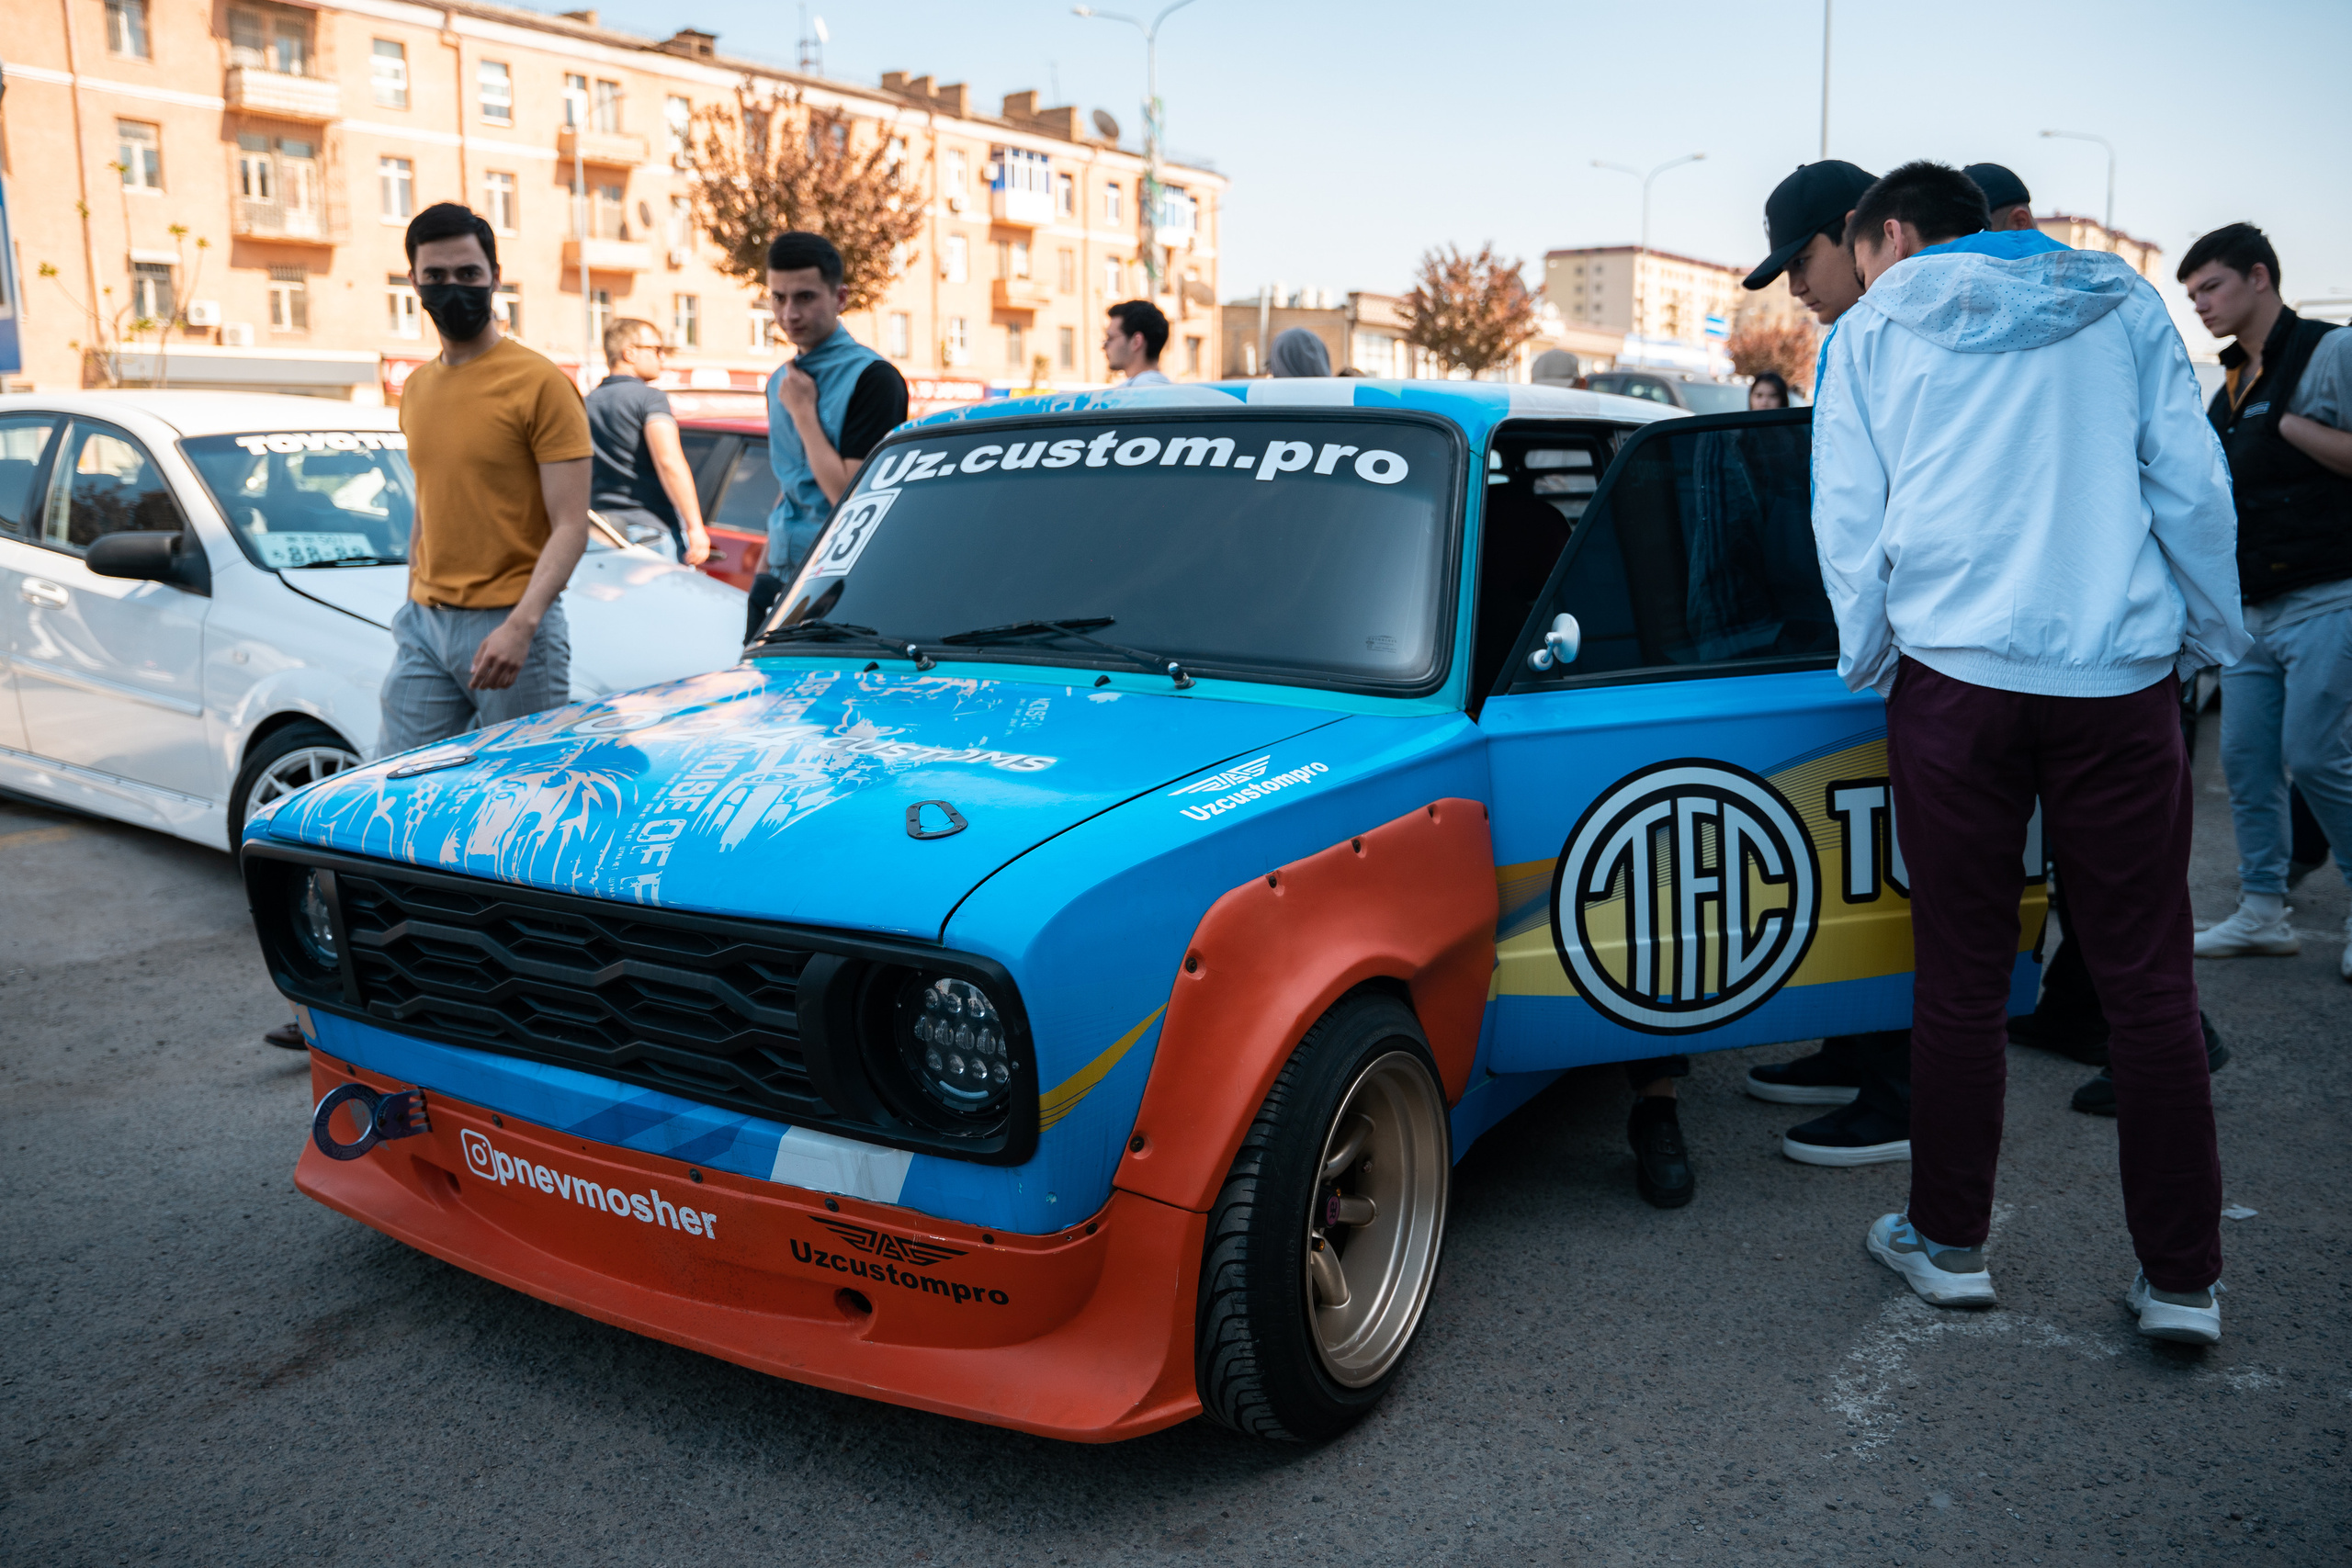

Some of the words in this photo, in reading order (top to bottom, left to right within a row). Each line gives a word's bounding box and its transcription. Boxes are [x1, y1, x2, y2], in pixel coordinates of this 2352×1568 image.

[870, 430, 1408, 491] Uz.custom.pro
[818, 737, 1057, 772] CUSTOMS
[1180, 761, 1329, 821] Uzcustompro
[620, 818, 687, 908] OFF
[492, 1149, 718, 1240] pnevmosher
[789, 1238, 1010, 1305] Uzcustompro
